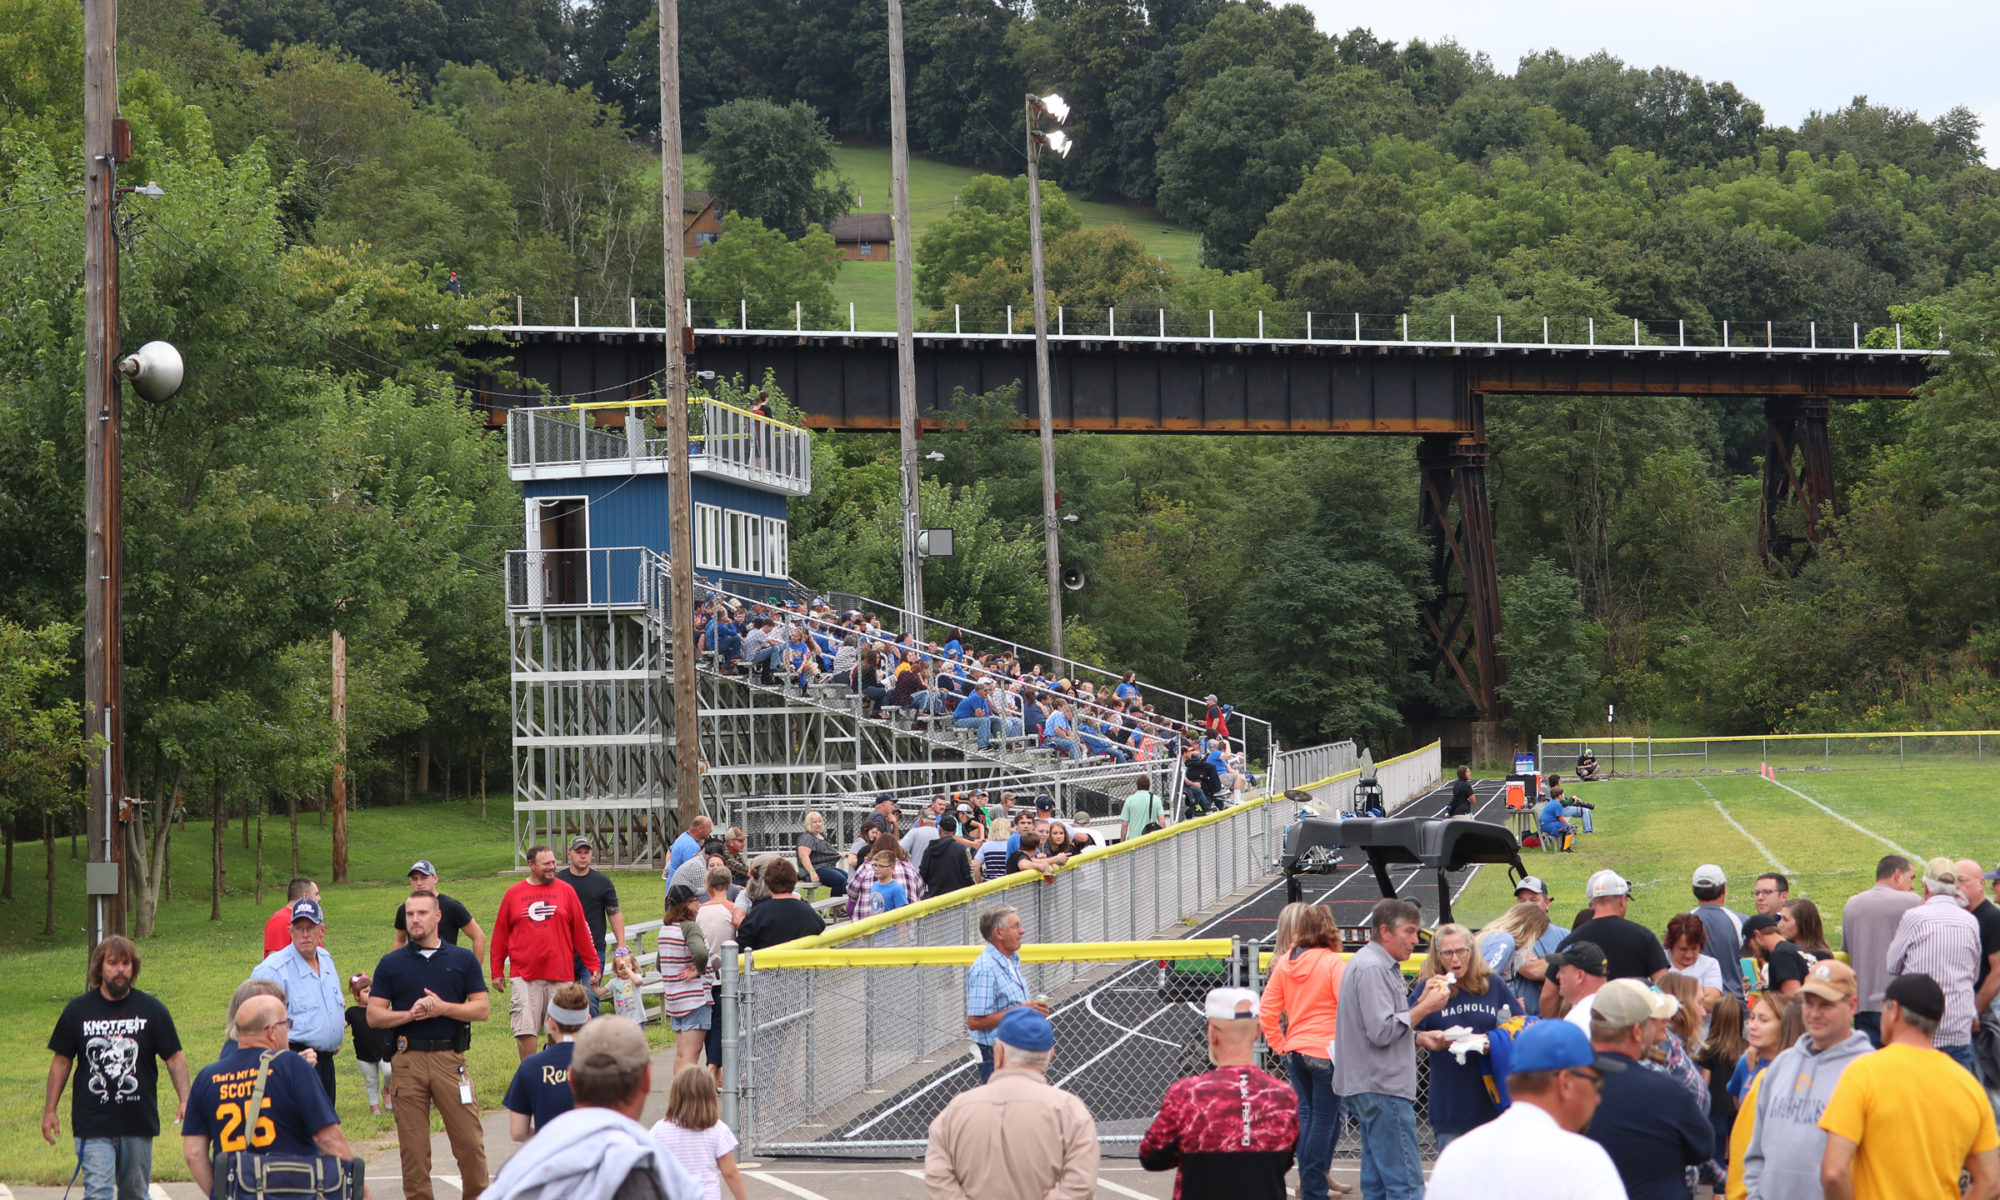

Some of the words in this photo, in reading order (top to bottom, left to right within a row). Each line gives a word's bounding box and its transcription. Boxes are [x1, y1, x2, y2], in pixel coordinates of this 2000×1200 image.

[1441, 1003, 1496, 1018] MAGNOLIA
[212, 1072, 235, 1084] That's
[236, 1068, 249, 1080] MY
[216, 1097, 277, 1153] 25
